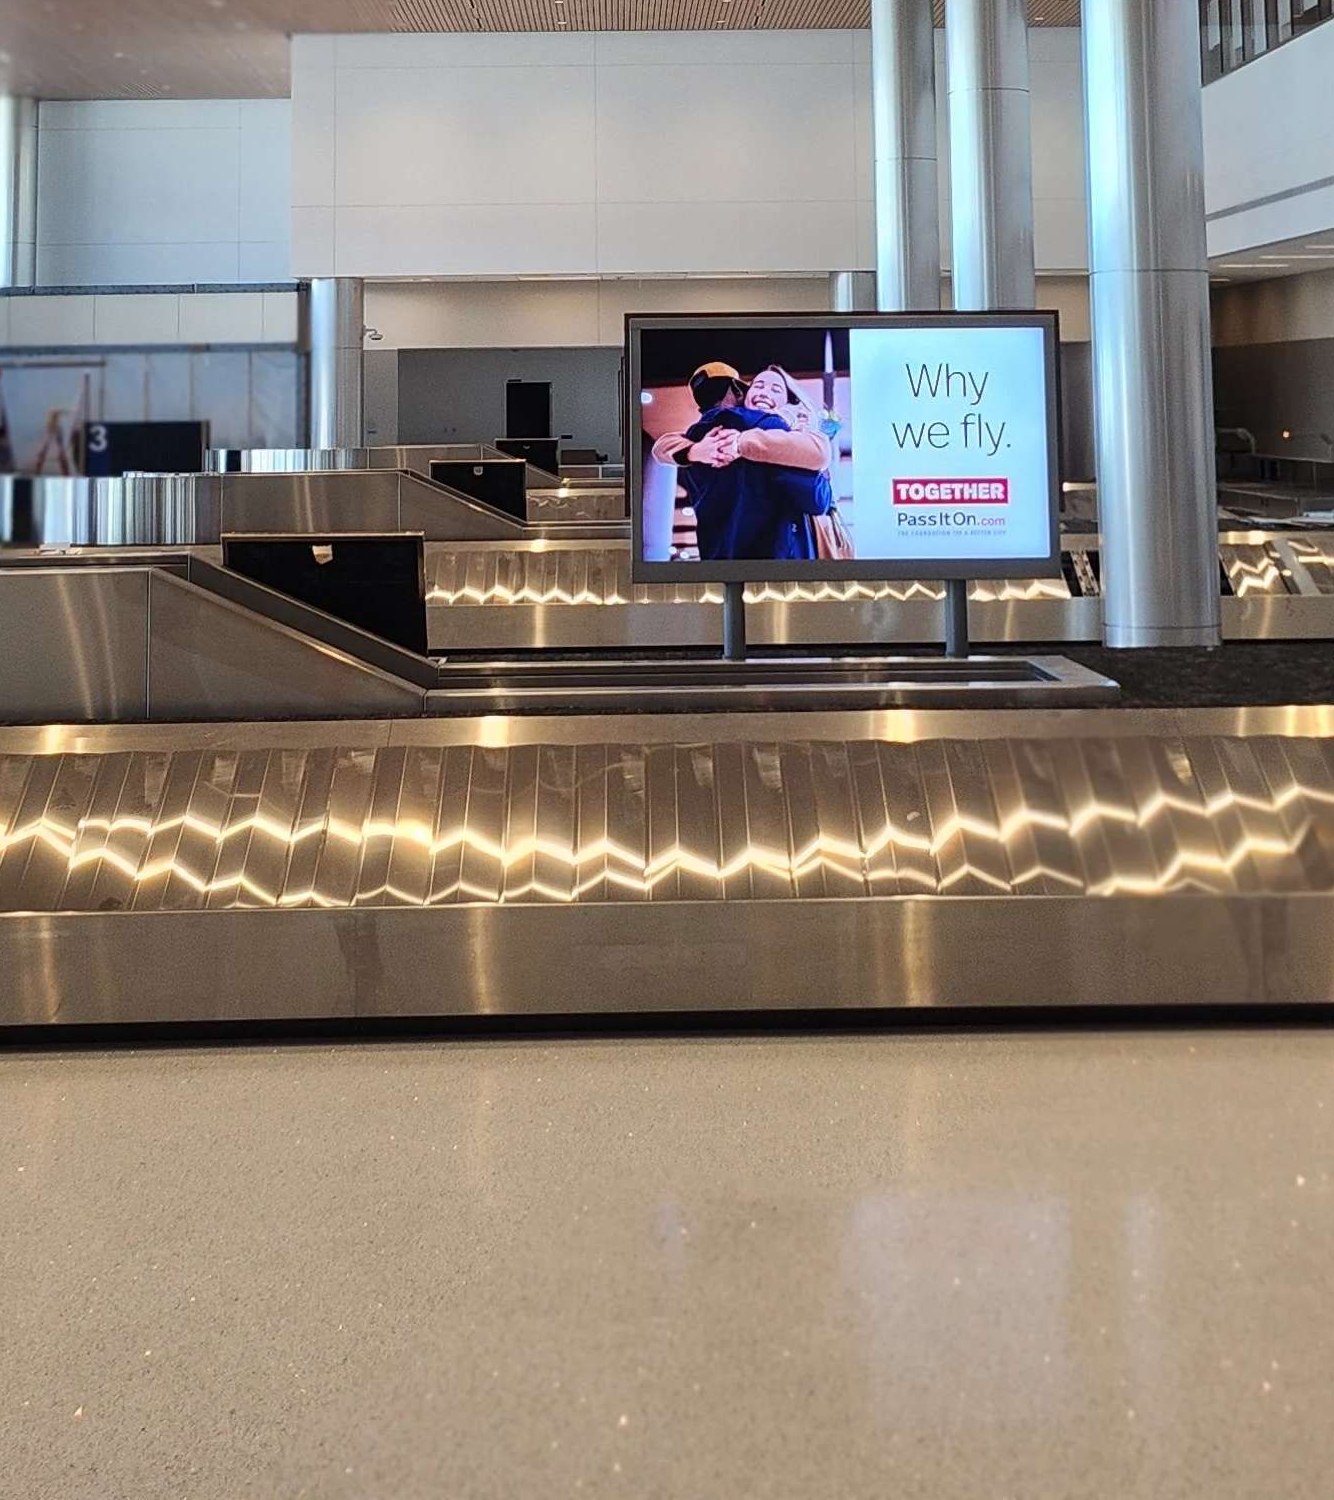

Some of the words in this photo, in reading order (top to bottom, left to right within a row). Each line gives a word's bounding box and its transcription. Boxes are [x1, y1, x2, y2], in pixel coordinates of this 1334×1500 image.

[905, 363, 989, 405] Why
[89, 425, 107, 452] 3
[893, 421, 950, 449] we
[960, 412, 1012, 456] fly.
[897, 483, 1005, 500] TOGETHER
[897, 511, 1006, 526] PassItOn.com
